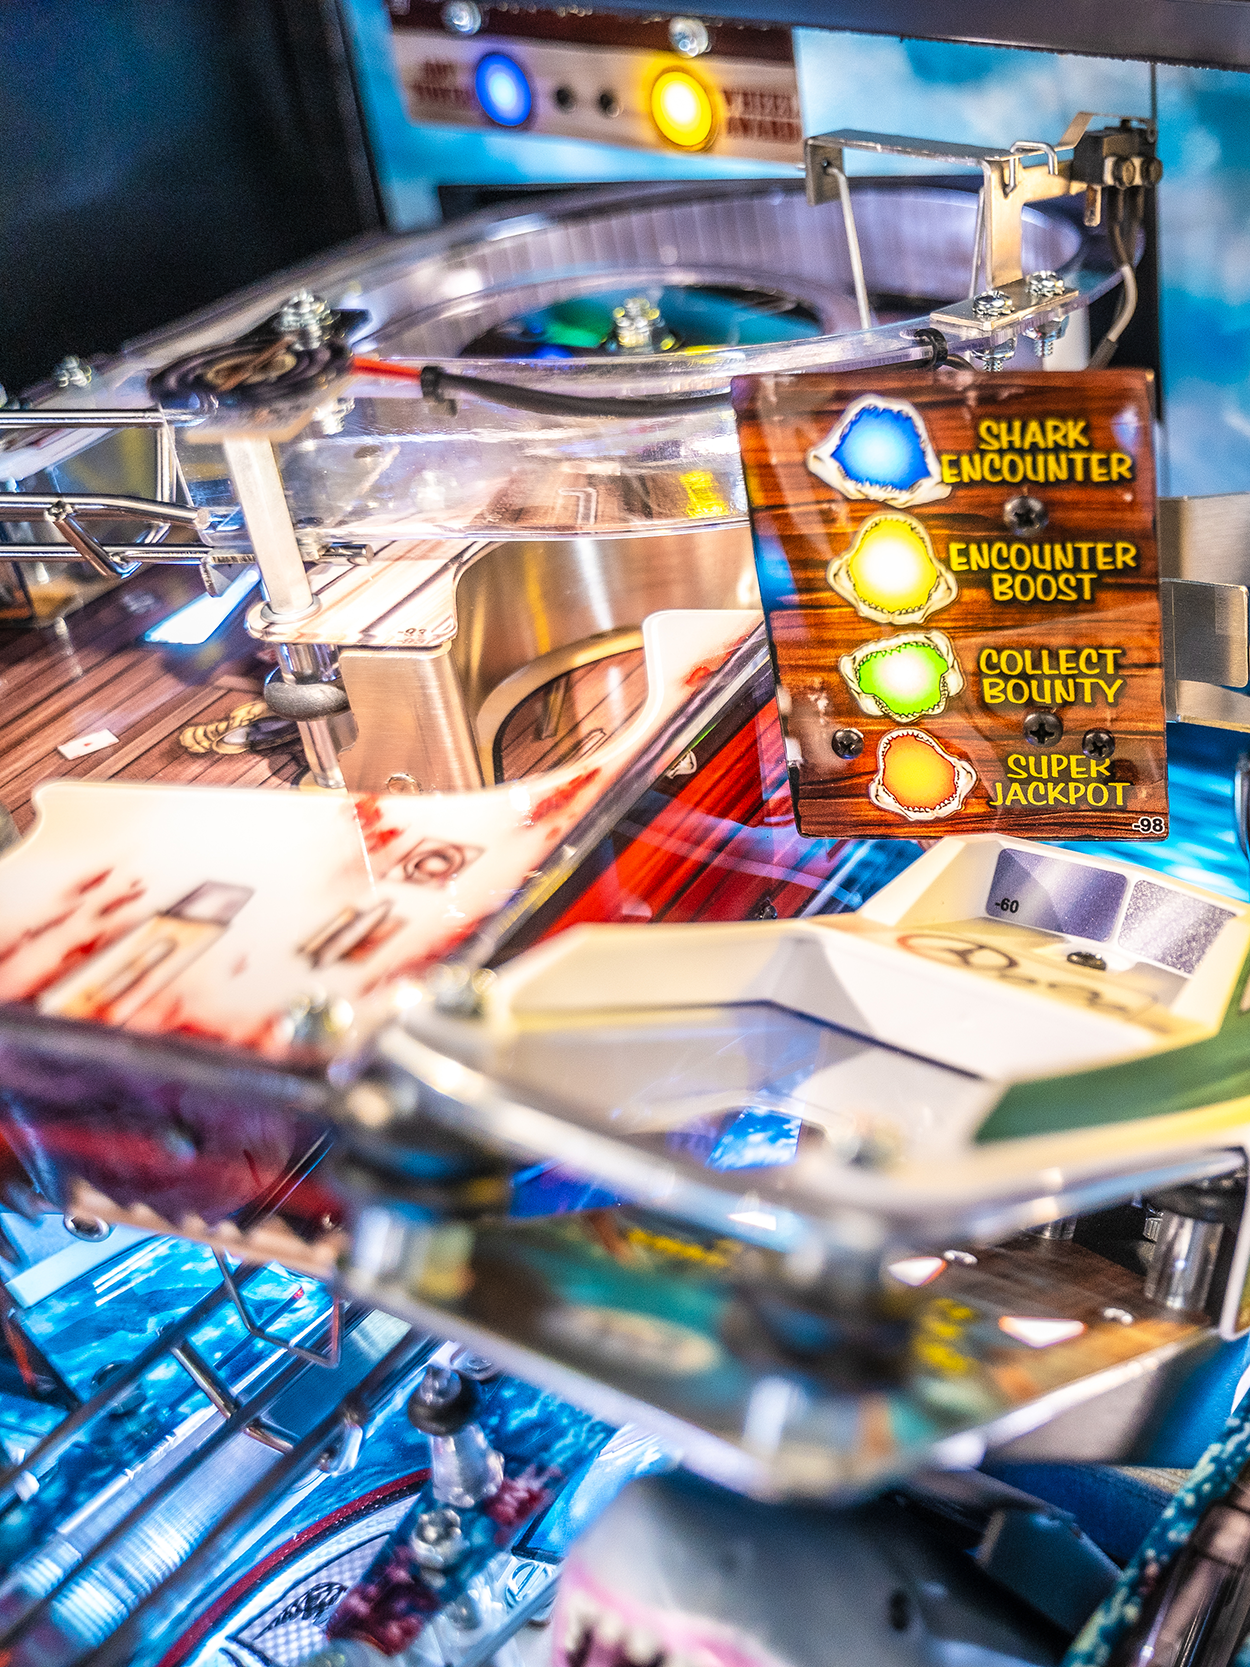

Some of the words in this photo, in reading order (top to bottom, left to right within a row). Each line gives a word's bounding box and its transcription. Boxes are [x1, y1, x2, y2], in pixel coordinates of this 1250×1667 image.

[979, 419, 1090, 450] SHARK
[943, 452, 1132, 484] ENCOUNTER
[949, 543, 1137, 572] ENCOUNTER
[992, 573, 1098, 601] BOOST
[979, 649, 1123, 676] COLLECT
[983, 678, 1124, 704] BOUNTY
[1007, 754, 1111, 779] SUPER
[991, 782, 1130, 806] JACKPOT
[1133, 818, 1165, 833] -98
[995, 898, 1019, 913] -60
